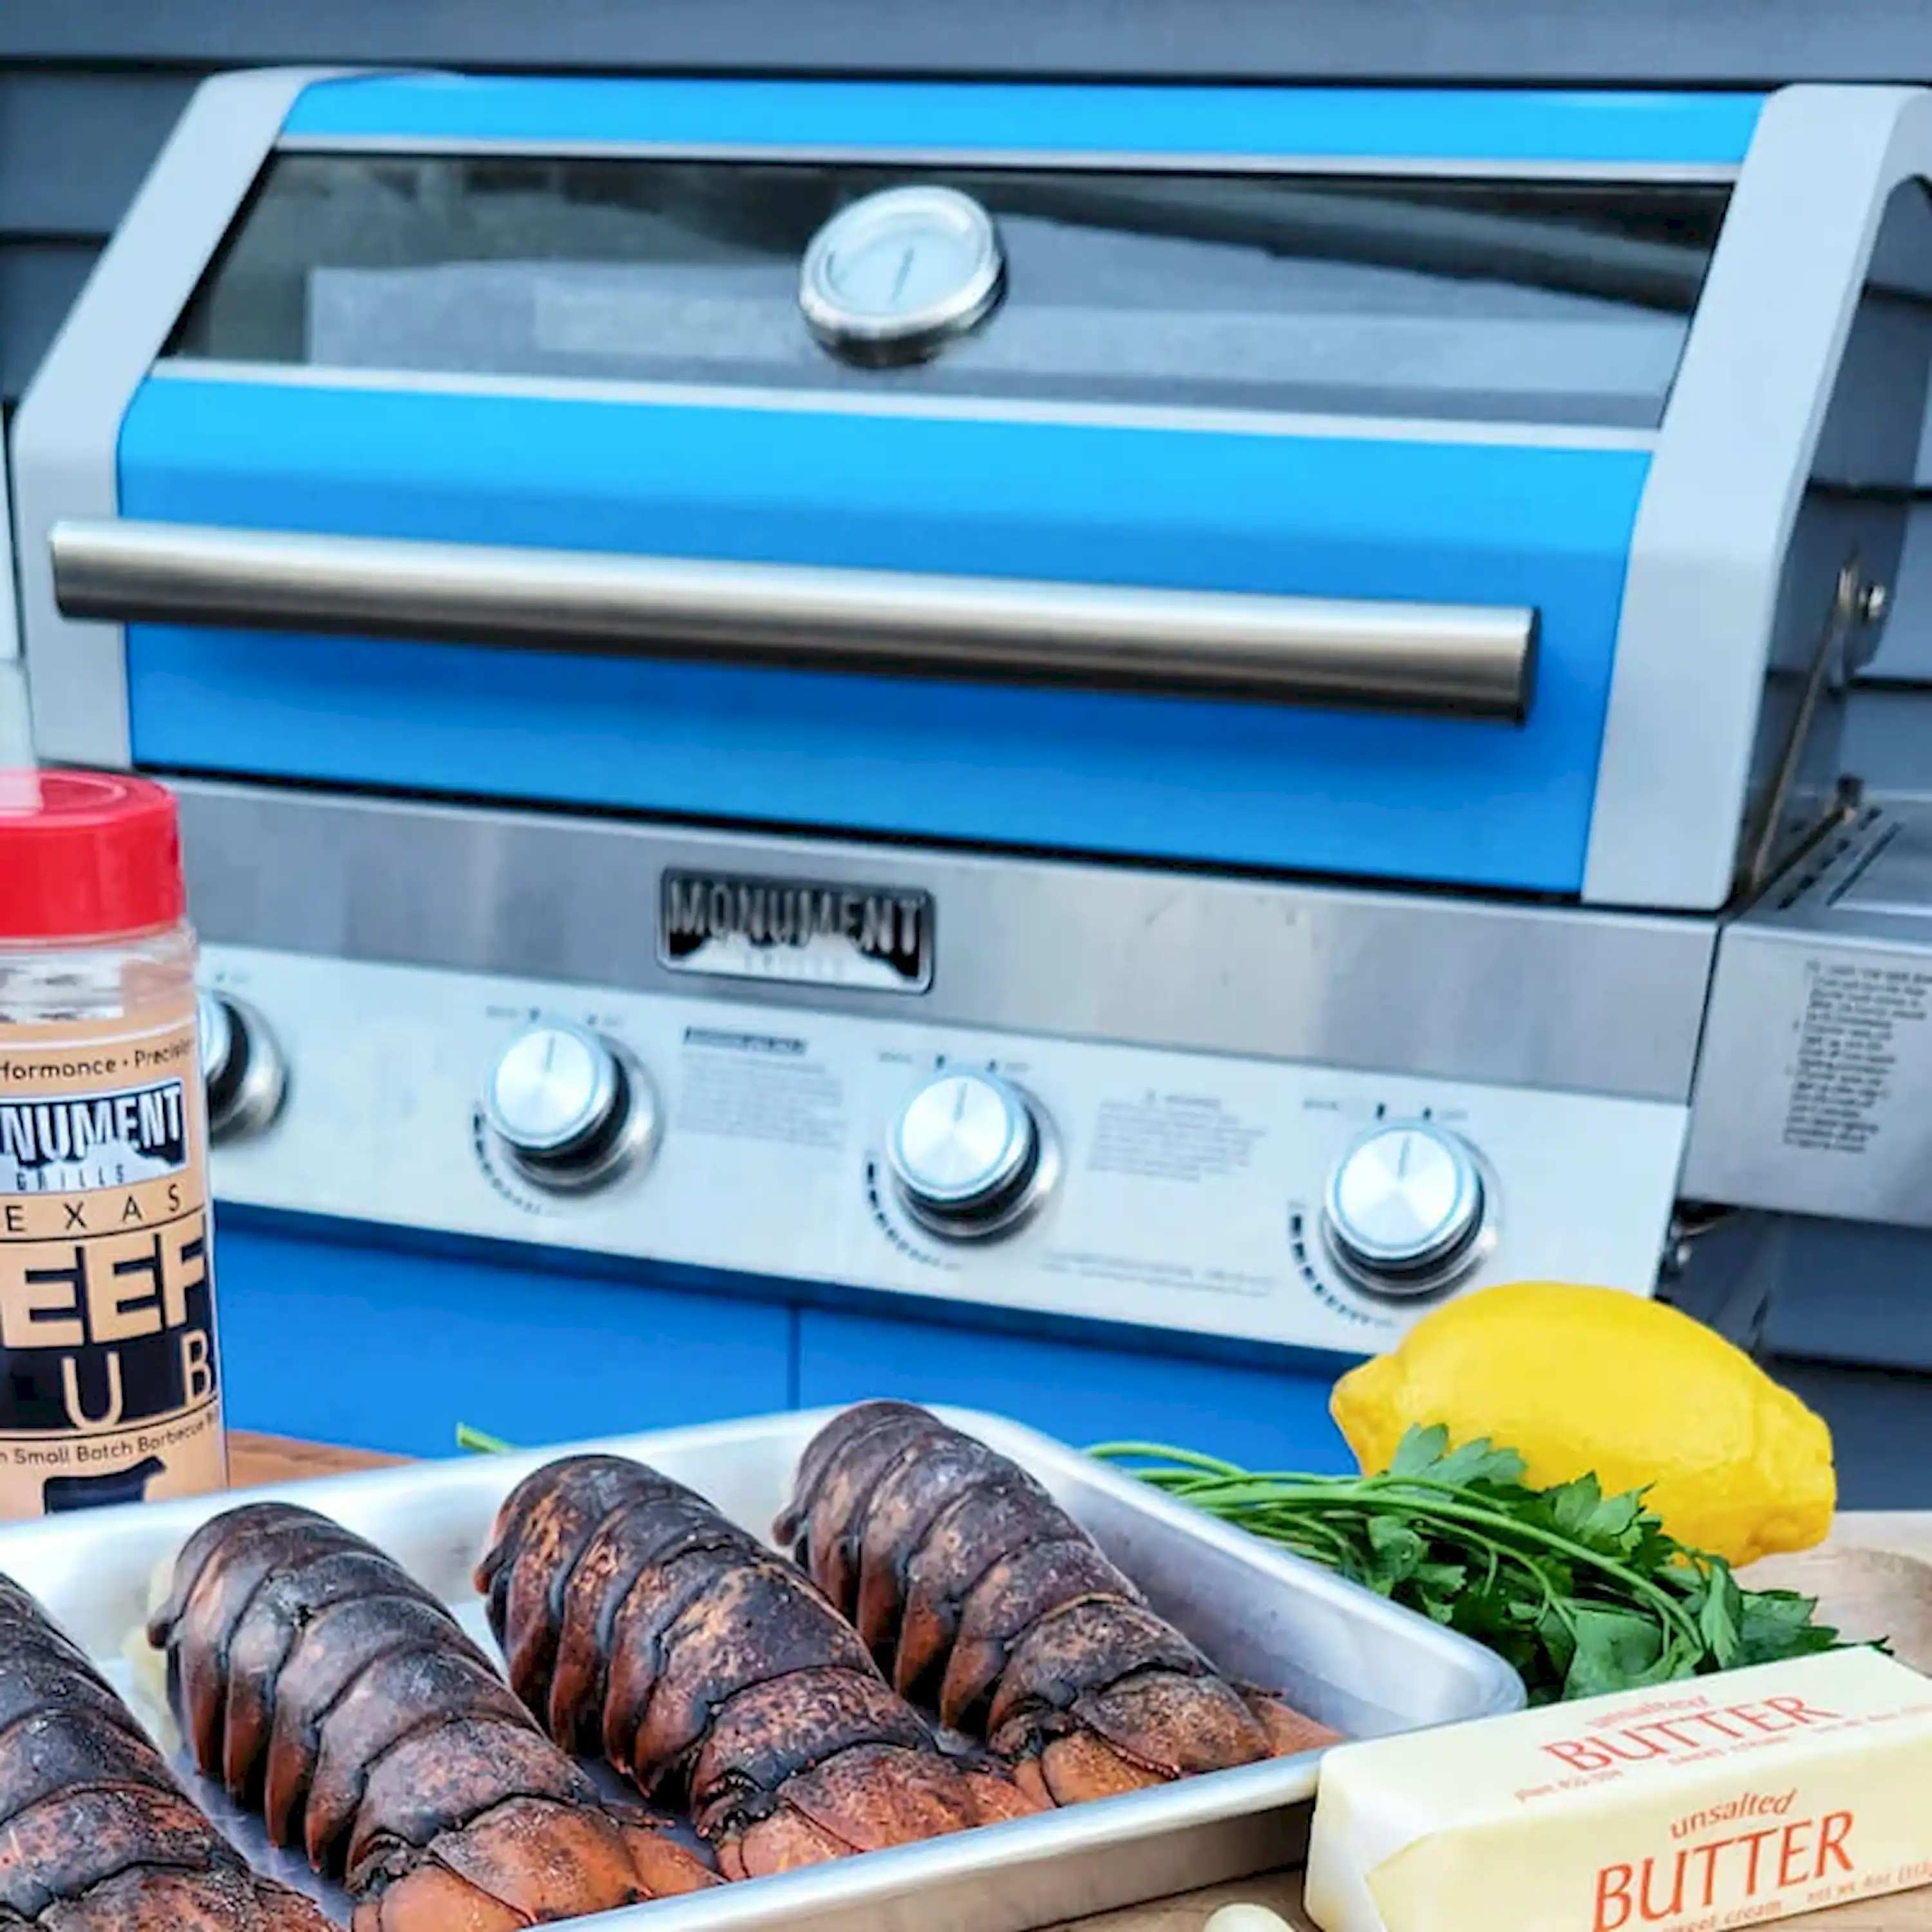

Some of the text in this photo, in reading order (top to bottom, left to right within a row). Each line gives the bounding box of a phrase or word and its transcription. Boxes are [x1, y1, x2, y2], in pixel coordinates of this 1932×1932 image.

[670, 880, 926, 956] MONUMENT
[5, 1182, 182, 1232] EXAS
[14, 1446, 70, 1465] Small
[77, 1439, 133, 1462] Batch
[1540, 1696, 1844, 1771] BUTTER
[1669, 1787, 1798, 1840] unsalted
[1592, 1809, 1856, 1932] BUTTER
